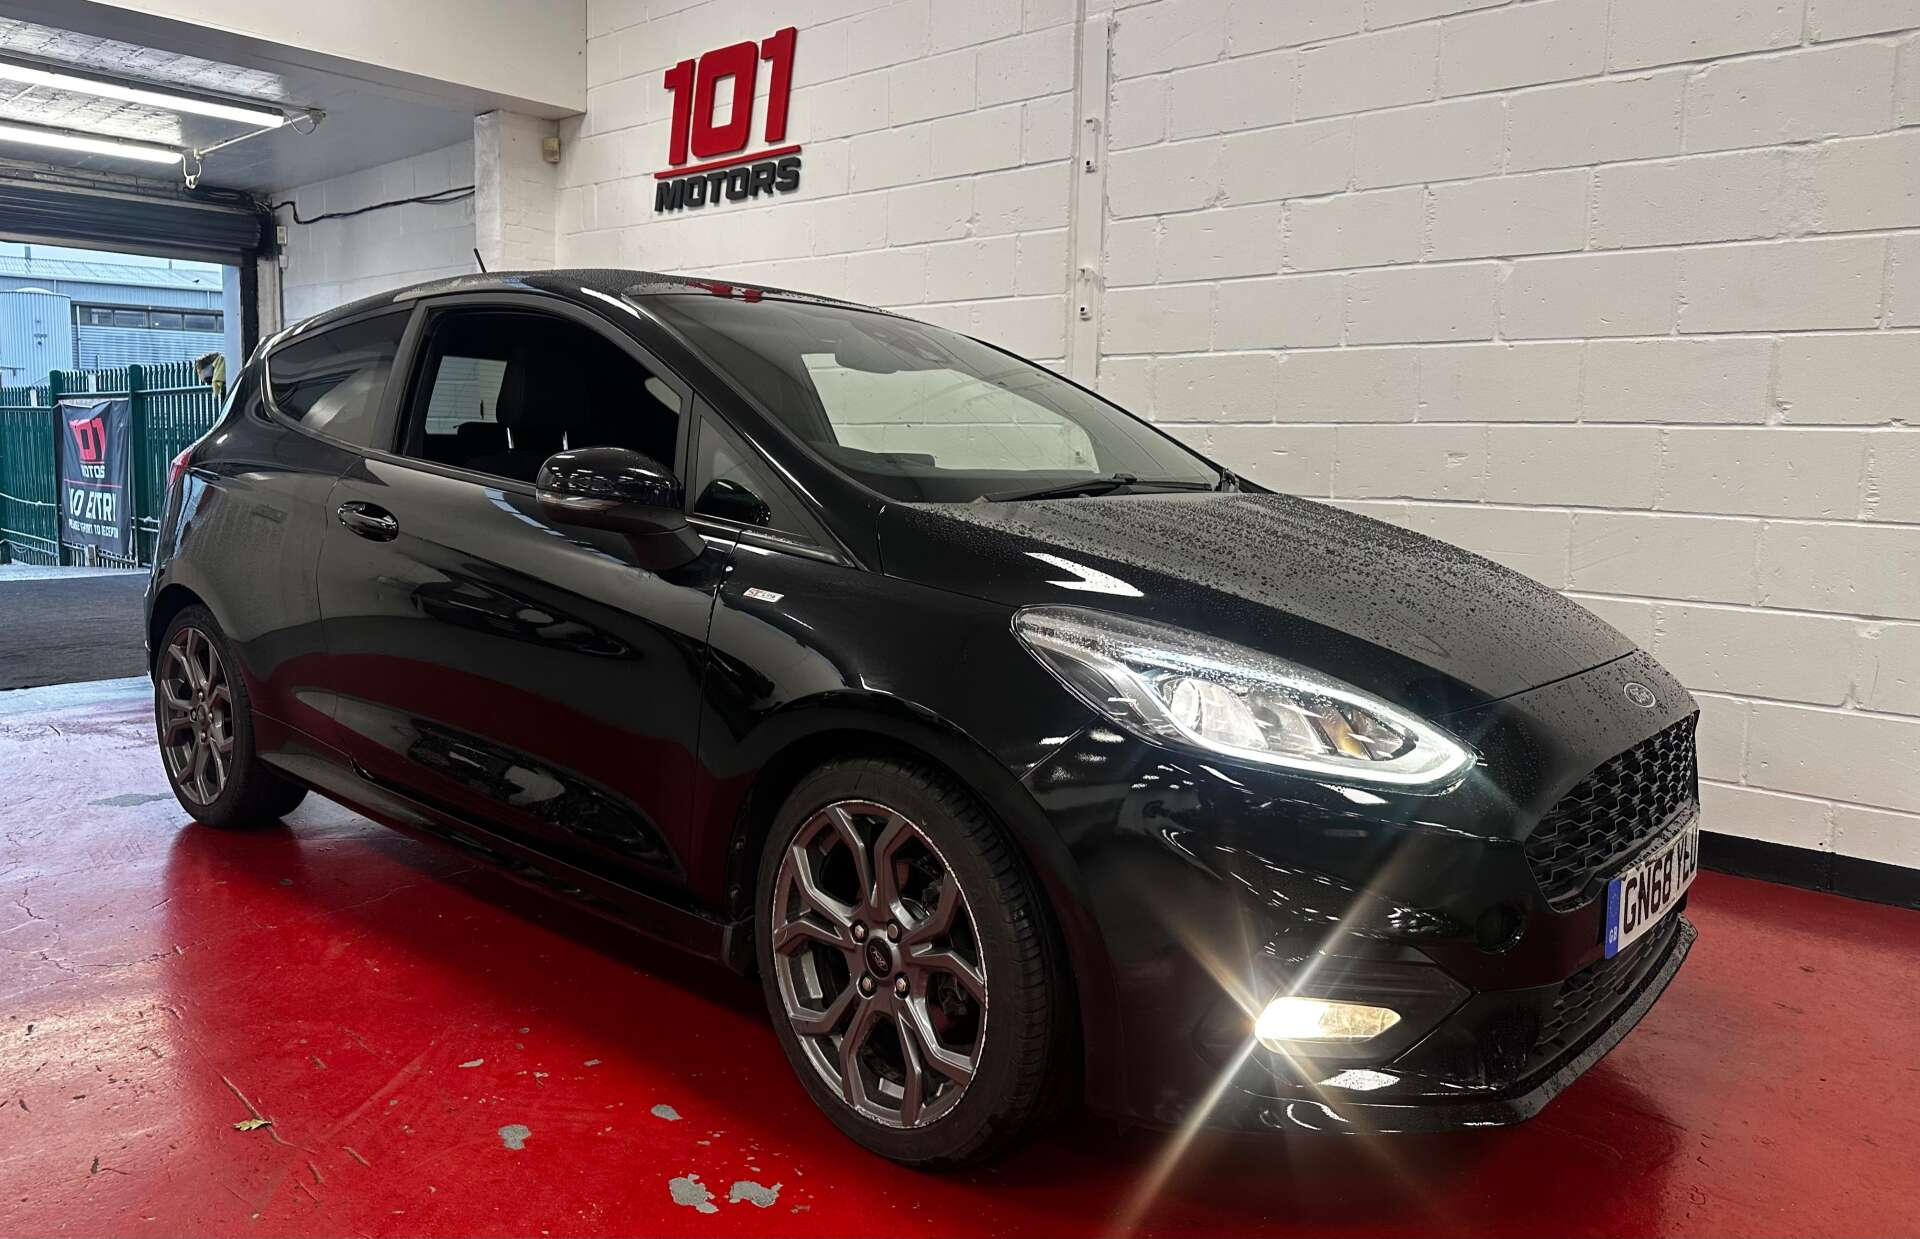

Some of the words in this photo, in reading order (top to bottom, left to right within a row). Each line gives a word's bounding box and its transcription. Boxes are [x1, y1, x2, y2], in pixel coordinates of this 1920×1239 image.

[664, 26, 797, 166] 101
[654, 157, 801, 212] MOTORS
[1623, 848, 1674, 934] GN68
[1609, 926, 1618, 944] GB
